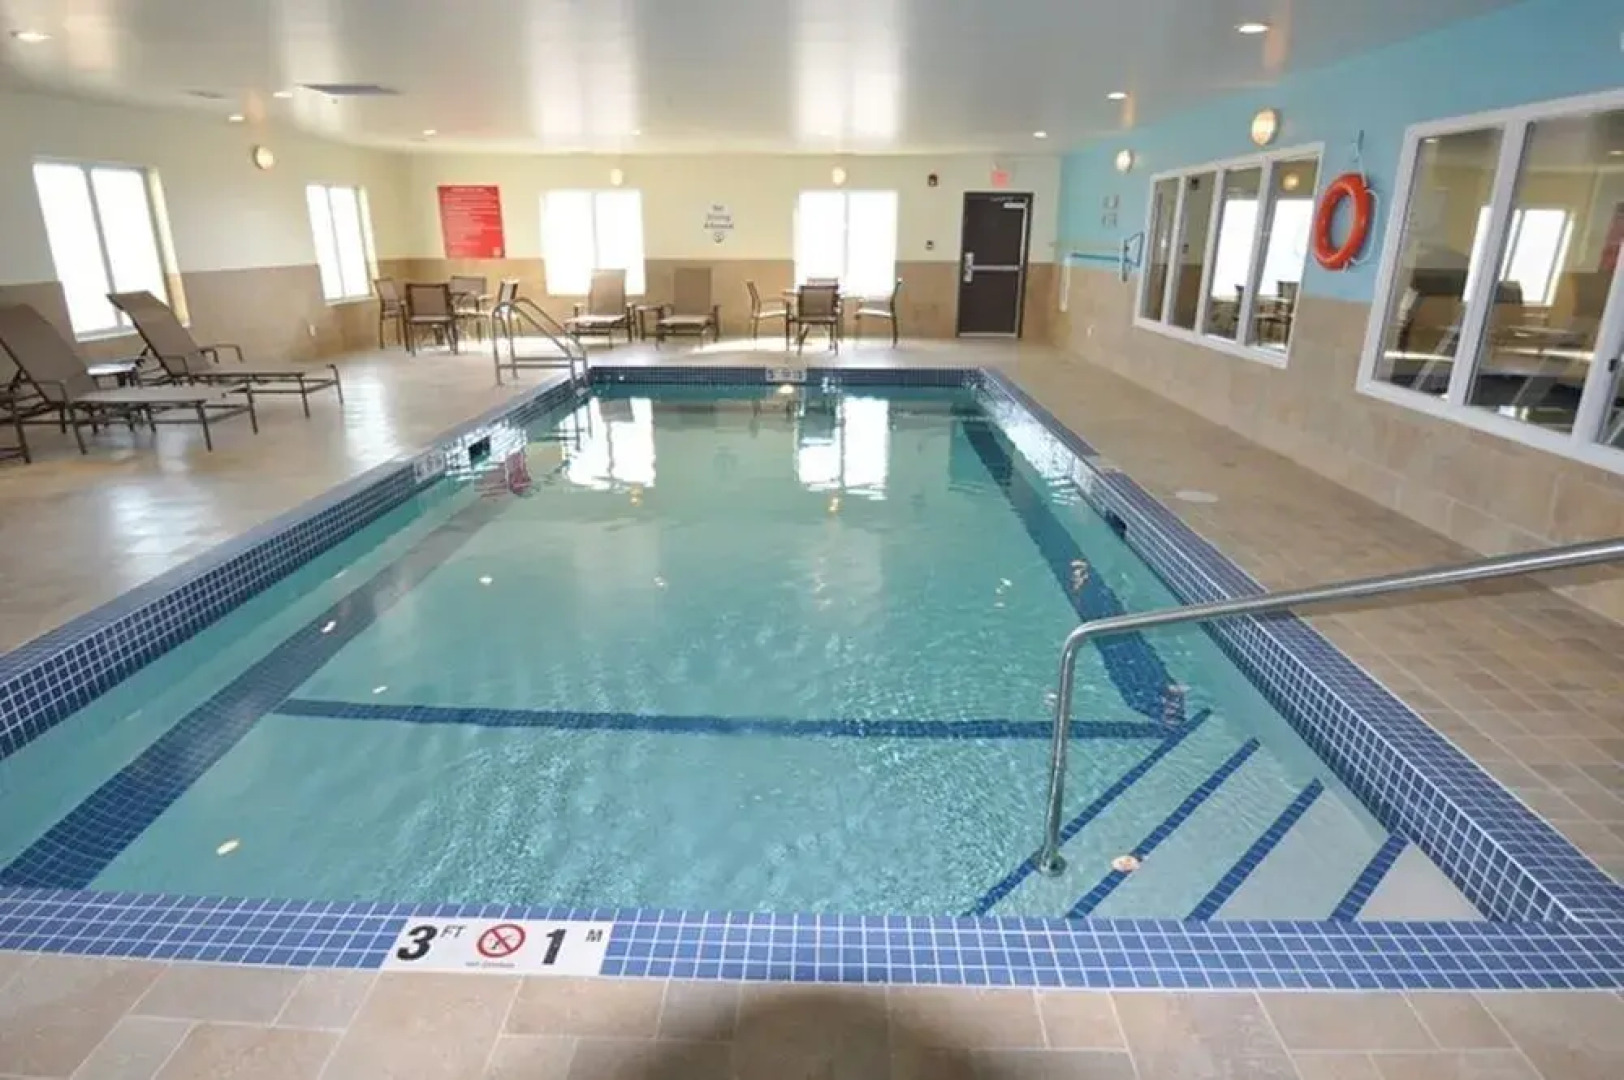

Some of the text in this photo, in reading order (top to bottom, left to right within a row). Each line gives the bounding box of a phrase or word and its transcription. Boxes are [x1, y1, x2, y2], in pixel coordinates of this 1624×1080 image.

[396, 924, 603, 965] 3 FT 1 M
